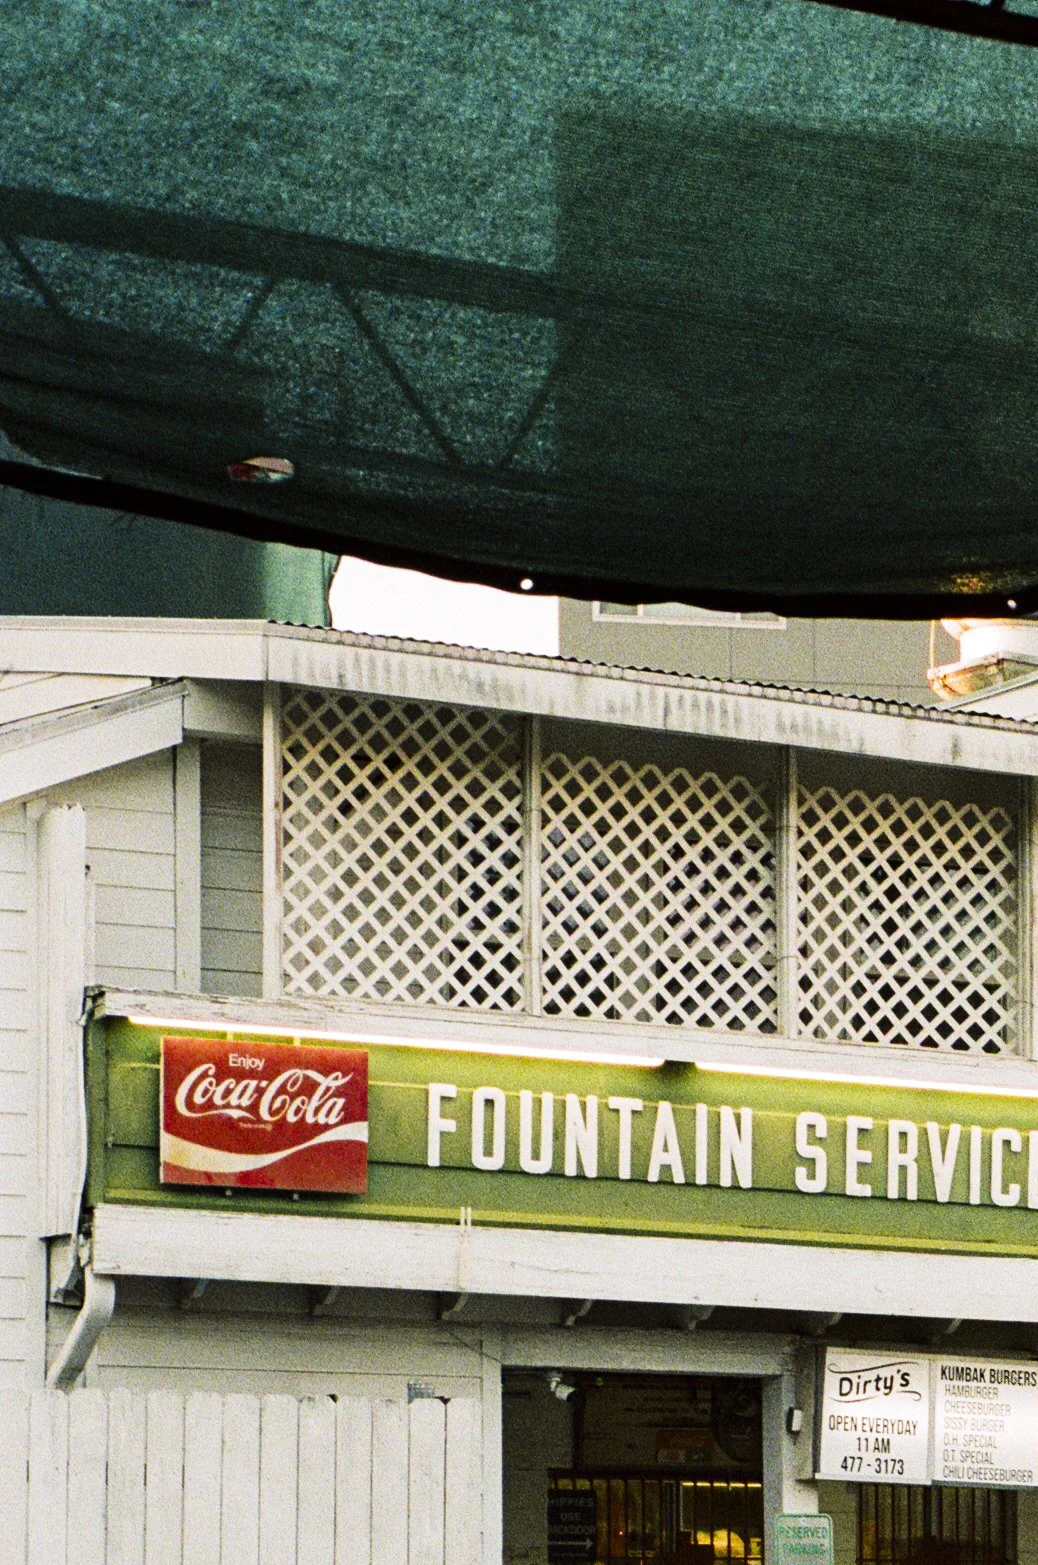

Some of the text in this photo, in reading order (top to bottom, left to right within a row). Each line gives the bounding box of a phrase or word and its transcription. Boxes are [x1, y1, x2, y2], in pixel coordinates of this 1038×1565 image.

[228, 1053, 265, 1070] Enjoy
[175, 1063, 353, 1125] Coca-Cola
[427, 1083, 754, 1189] FOUNTAIN
[838, 1369, 911, 1397] Dirty's
[940, 1365, 1037, 1387] KUMBAK BURGERS
[944, 1384, 999, 1400] HAMBURGER
[944, 1400, 1011, 1416] CHEESEBURGER
[828, 1414, 918, 1436] OPEN EVERYDAY
[944, 1417, 1005, 1433] SISSY BURGER
[856, 1437, 891, 1454] 11 AM
[963, 1435, 998, 1449] SPECIAL
[840, 1456, 864, 1473] 477
[874, 1458, 905, 1476] 3173
[960, 1450, 994, 1465] SPECIAL
[942, 1465, 1034, 1483] CHILI CHEESEBURGER
[560, 1512, 582, 1522] USE
[779, 1526, 828, 1539] RESERVED
[783, 1543, 826, 1556] PARKING
